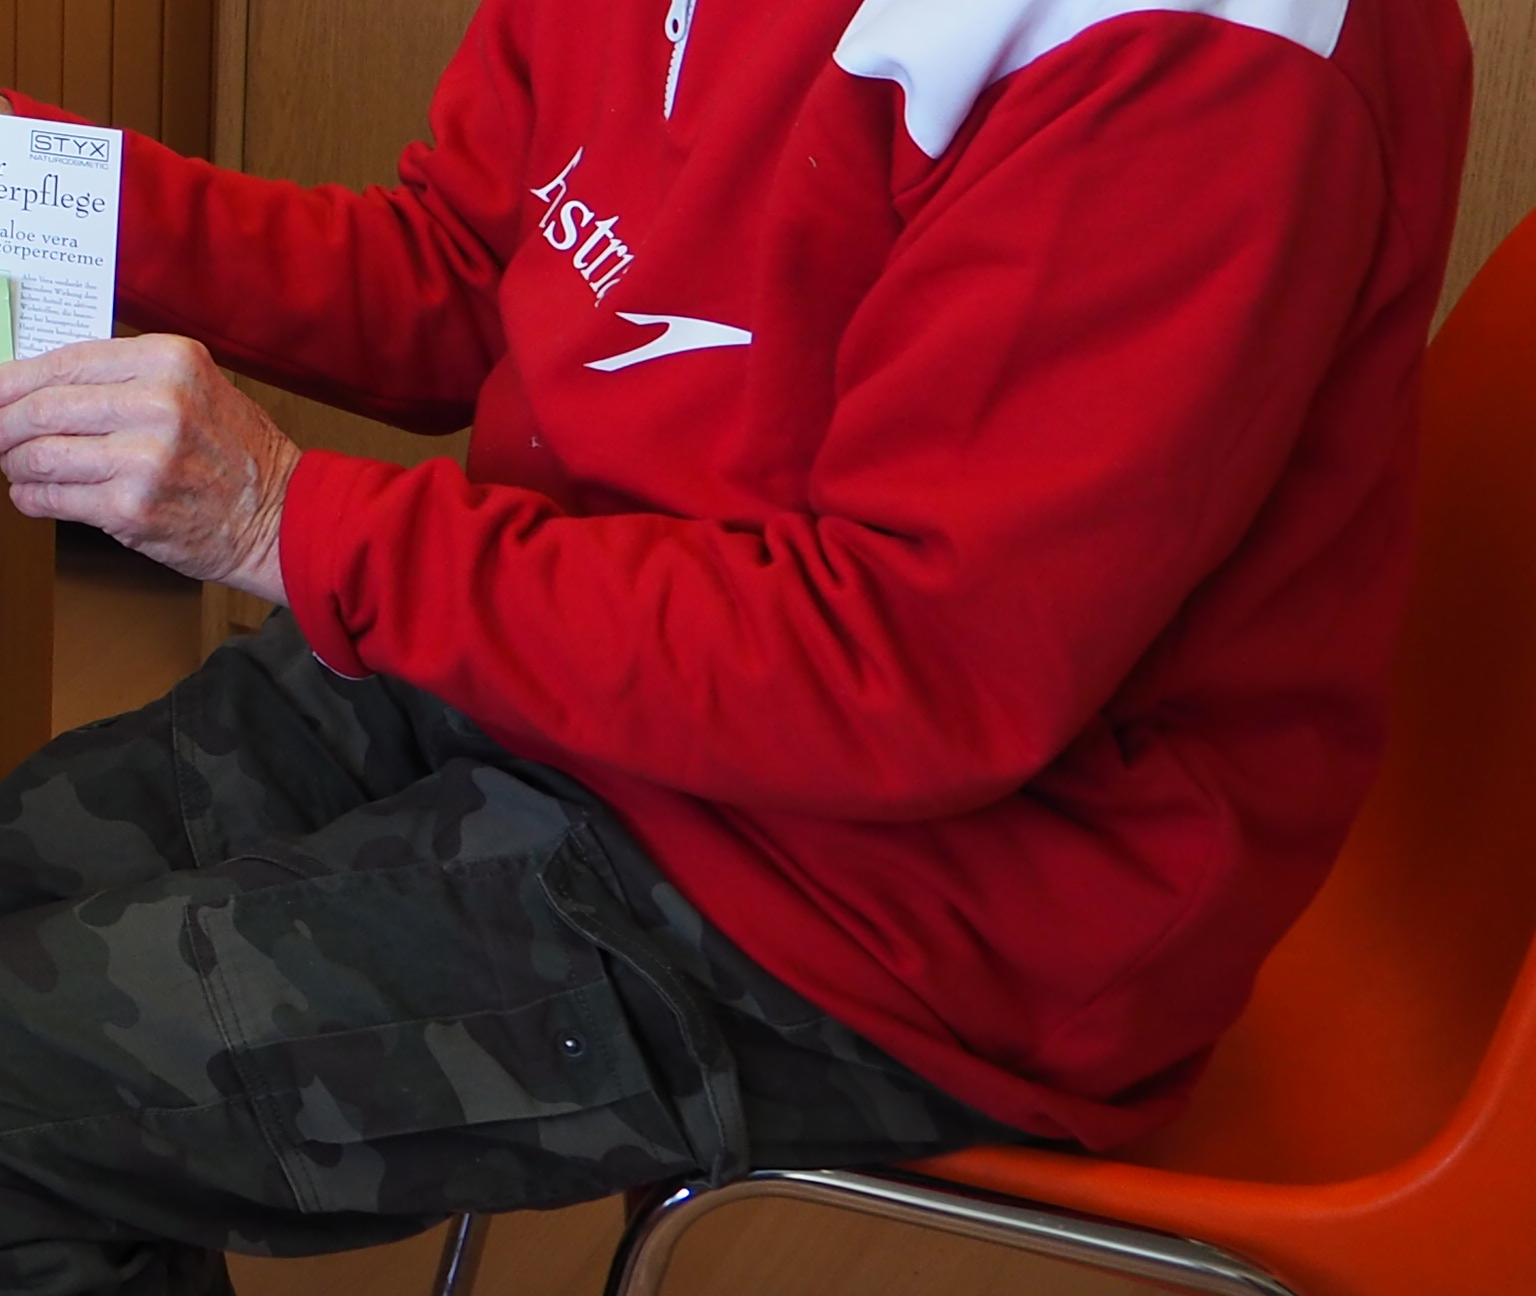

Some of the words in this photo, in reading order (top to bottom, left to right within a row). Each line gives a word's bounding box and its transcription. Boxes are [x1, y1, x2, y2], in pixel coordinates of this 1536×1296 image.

[33, 134, 107, 159] STYX
[29, 153, 110, 172] NATURCOSMETIC
[41, 234, 79, 250] vera
